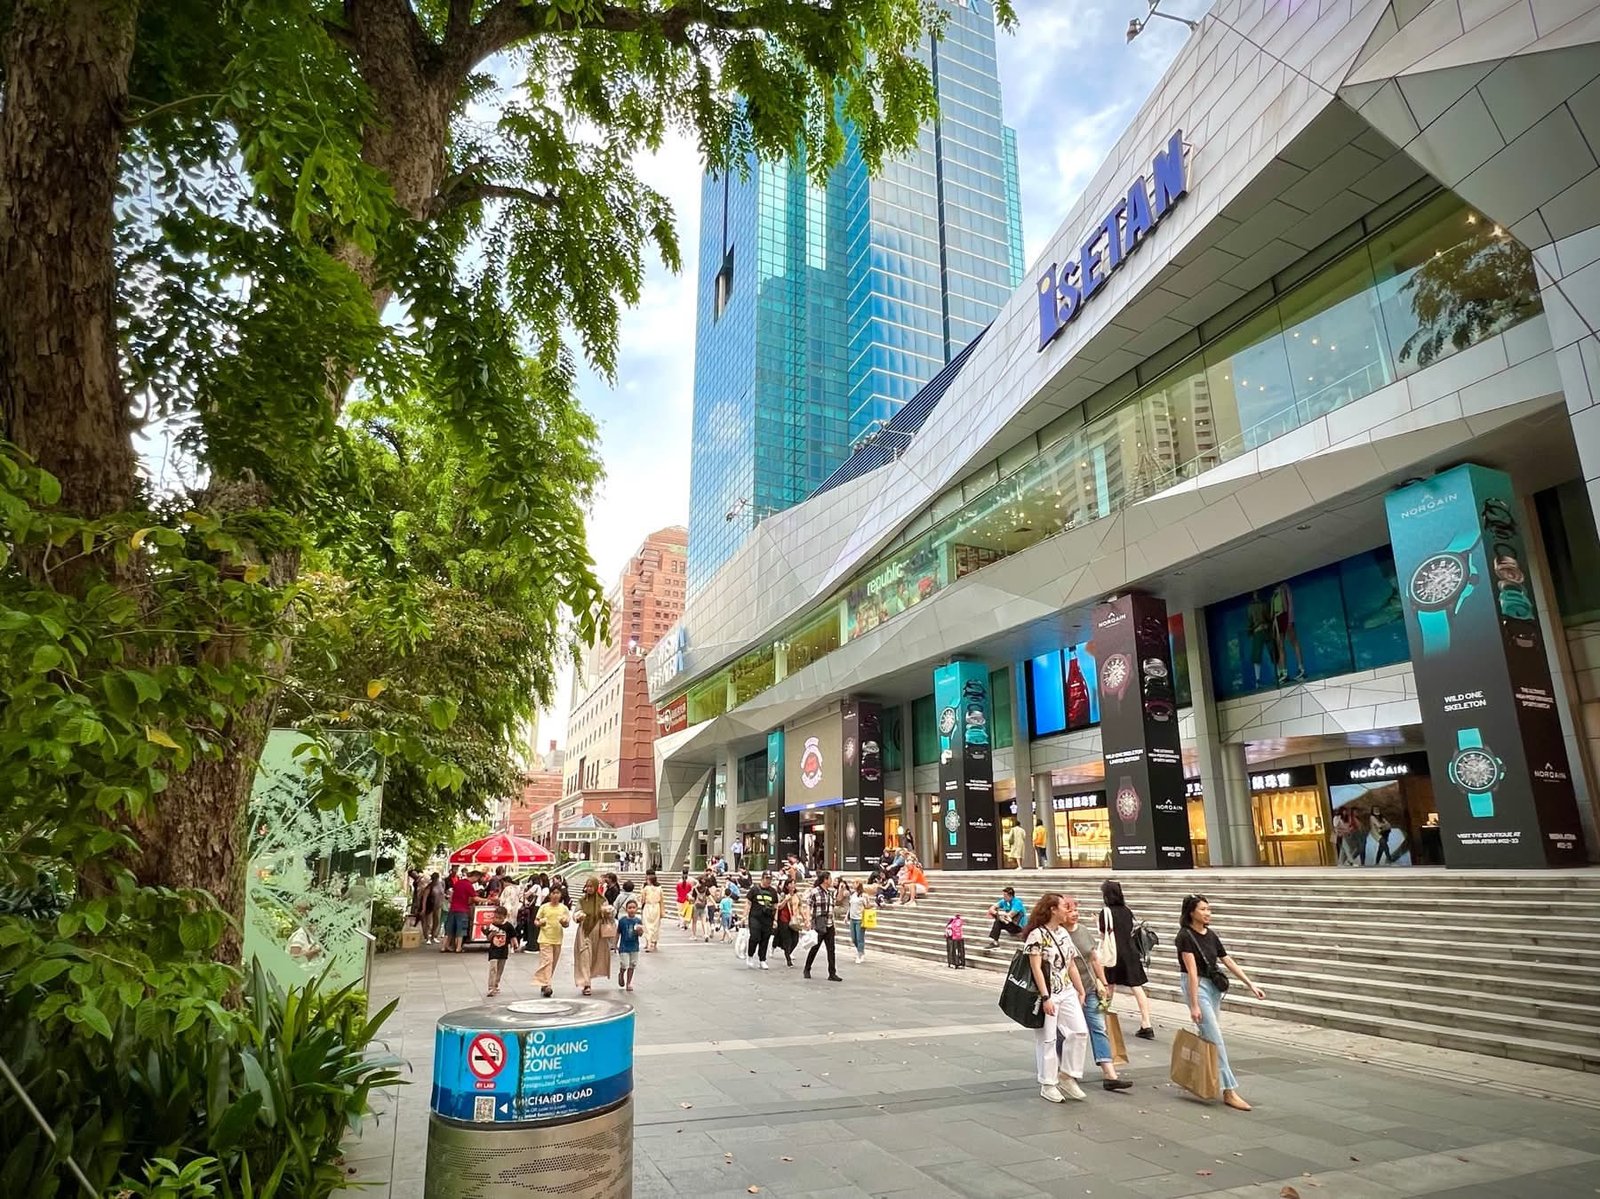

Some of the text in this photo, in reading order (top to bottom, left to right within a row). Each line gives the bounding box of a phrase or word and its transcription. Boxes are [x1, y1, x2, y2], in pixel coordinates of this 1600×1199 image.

[1444, 690, 1484, 703] WILD ONE
[1444, 699, 1487, 712] SKELETON
[1350, 764, 1408, 779] NORQAIN
[524, 1040, 589, 1059] SMOKING
[523, 1057, 563, 1073] ZONE
[566, 1087, 594, 1101] ROAD
